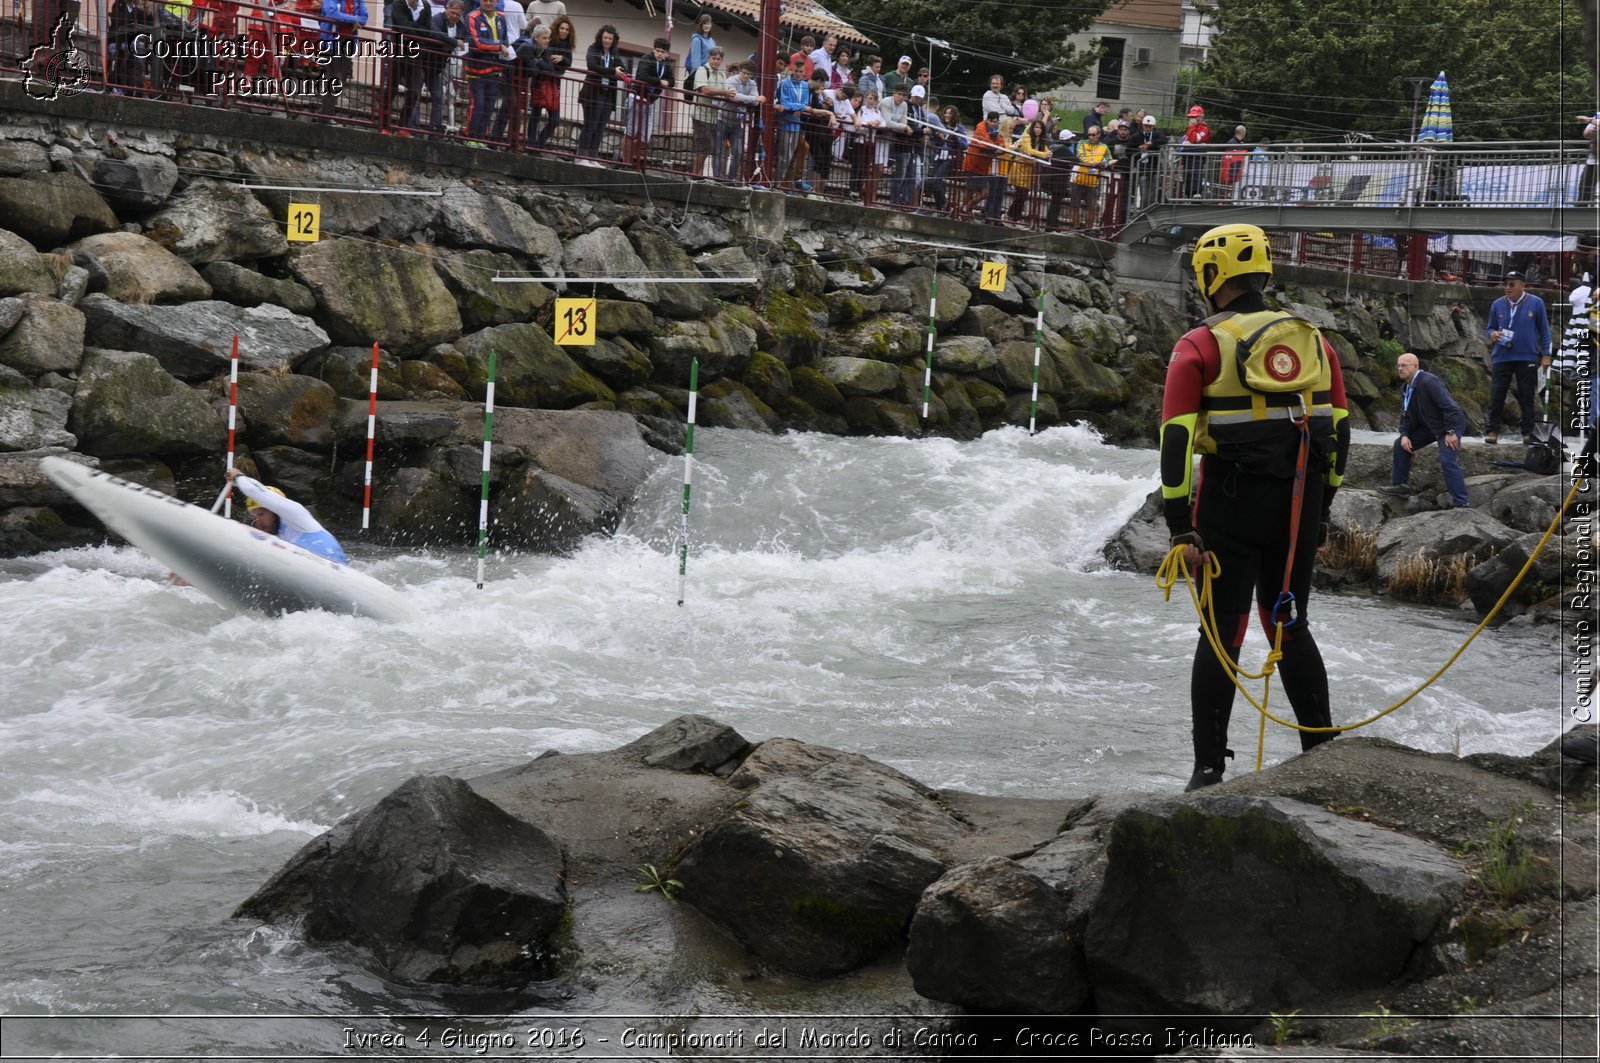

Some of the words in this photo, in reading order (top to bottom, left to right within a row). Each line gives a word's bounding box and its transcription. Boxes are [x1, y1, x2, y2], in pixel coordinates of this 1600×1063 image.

[294, 211, 314, 234] 12
[987, 268, 1001, 286] 11
[563, 307, 588, 336] 13
